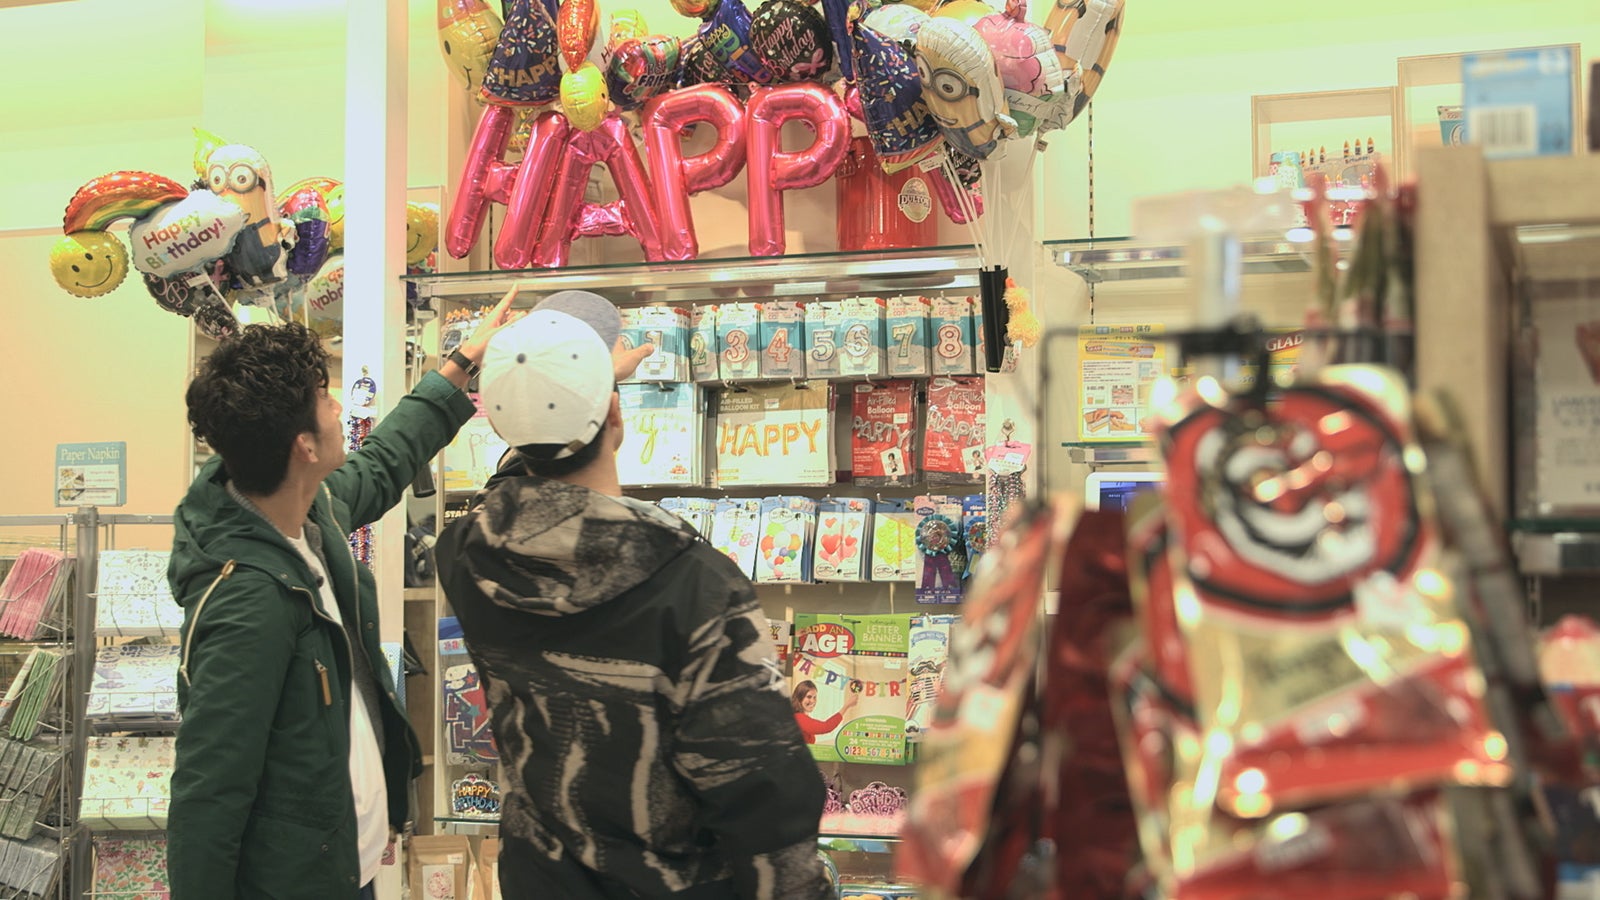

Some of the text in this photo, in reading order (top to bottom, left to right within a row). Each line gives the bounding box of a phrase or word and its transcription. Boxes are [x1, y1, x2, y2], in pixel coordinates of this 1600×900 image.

[752, 18, 793, 58] Happy
[767, 29, 815, 77] Birthday
[142, 213, 201, 250] Happy
[145, 217, 226, 270] Birthday!
[690, 332, 706, 367] 2
[724, 329, 749, 364] 3
[767, 328, 791, 363] 4
[812, 329, 836, 362] 5
[844, 323, 871, 358] 6
[892, 324, 916, 358] 7
[937, 325, 963, 360] 8
[1265, 333, 1304, 351] GLAD
[867, 406, 896, 415] Balloon
[719, 418, 822, 457] HAPPY
[852, 415, 911, 449] PARTY
[61, 446, 120, 464] Paper Napkin
[802, 633, 849, 654] AGE
[805, 624, 844, 635] ADD AN
[862, 632, 903, 643] BANNER
[866, 624, 899, 635] LETTER
[458, 785, 491, 798] HAPPY
